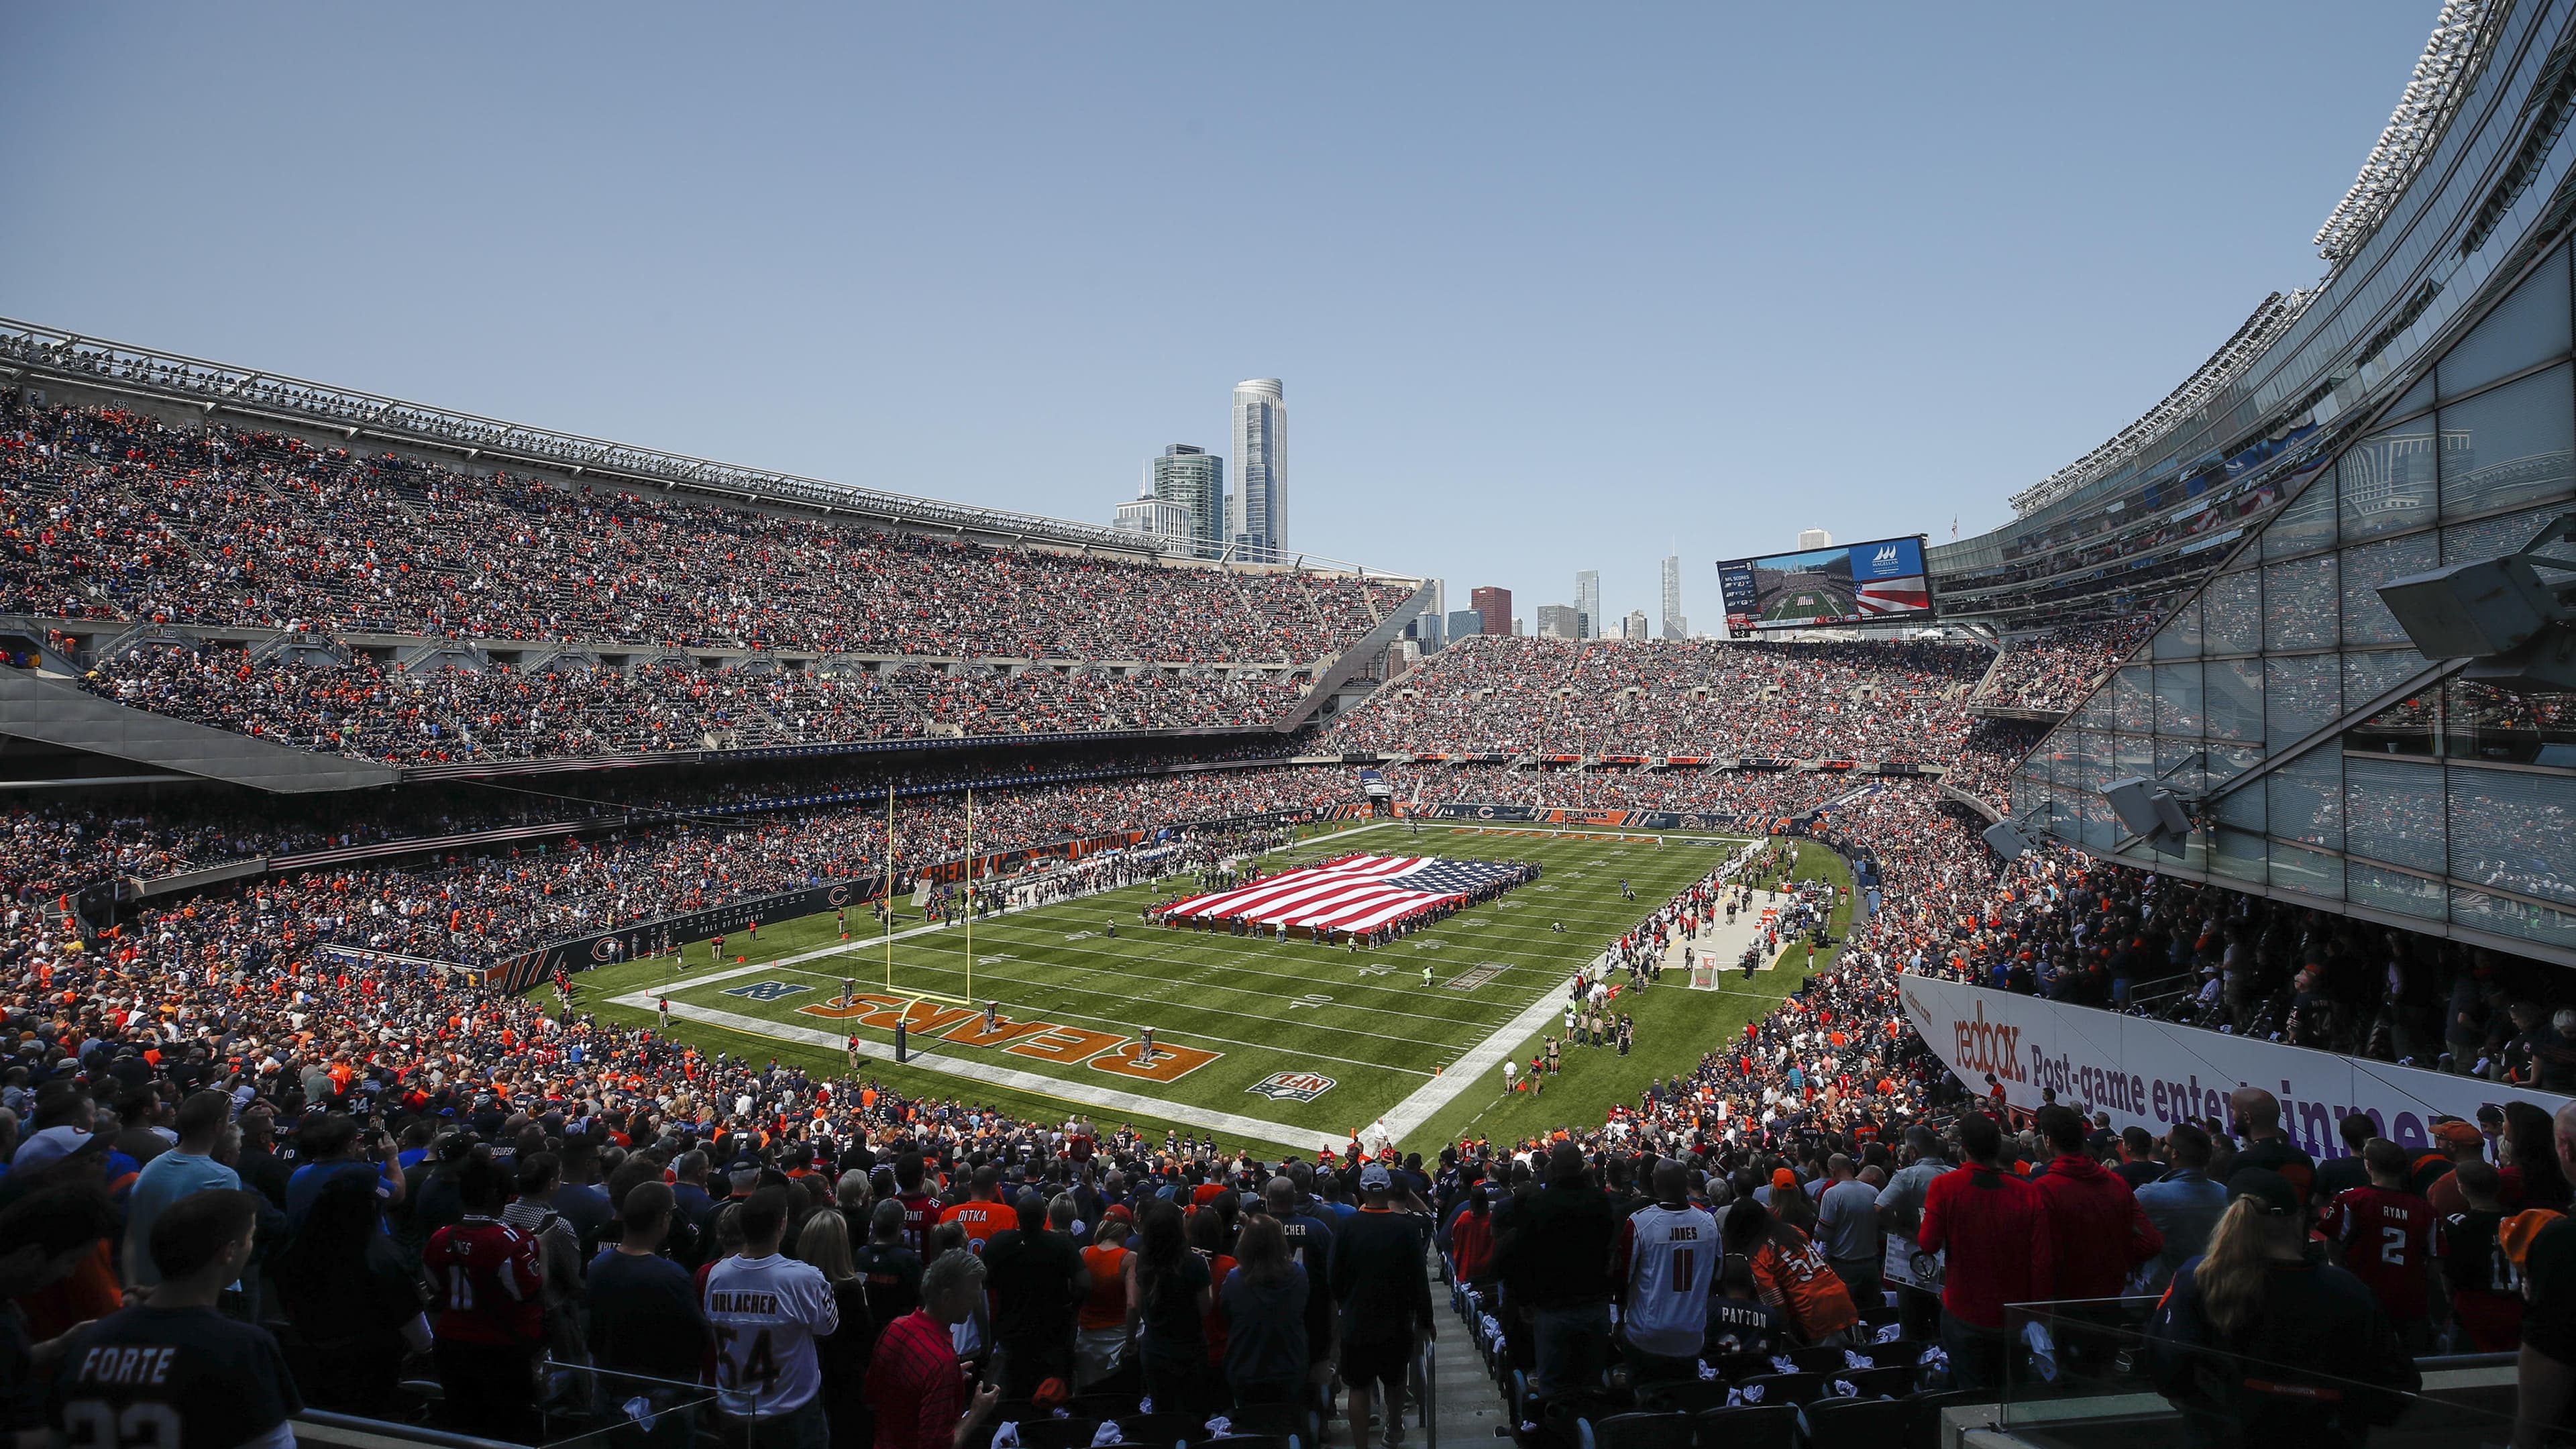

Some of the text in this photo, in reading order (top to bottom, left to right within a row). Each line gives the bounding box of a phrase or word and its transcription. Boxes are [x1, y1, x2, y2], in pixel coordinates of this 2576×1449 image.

[699, 923, 718, 933] HALL
[722, 920, 731, 928] OF
[735, 913, 764, 925] FAMERS
[1358, 964, 1398, 977] 20
[1289, 994, 1334, 1010] 10
[794, 994, 1226, 1083] BEARS
[1276, 1075, 1328, 1091] NFL
[2031, 1044, 2146, 1115] Post-game
[904, 1210, 923, 1222] FANT
[957, 1210, 988, 1222] DITKA
[2383, 1205, 2408, 1221] RYAN
[1669, 1227, 1697, 1242] JONES
[445, 1239, 472, 1256] JNES
[2381, 1227, 2406, 1266] 2
[1673, 1248, 1694, 1293] 11
[712, 1293, 777, 1315] URLACHER
[1721, 1307, 1767, 1329] PAYTON
[78, 1347, 176, 1385] FORTE
[714, 1325, 782, 1395] 54
